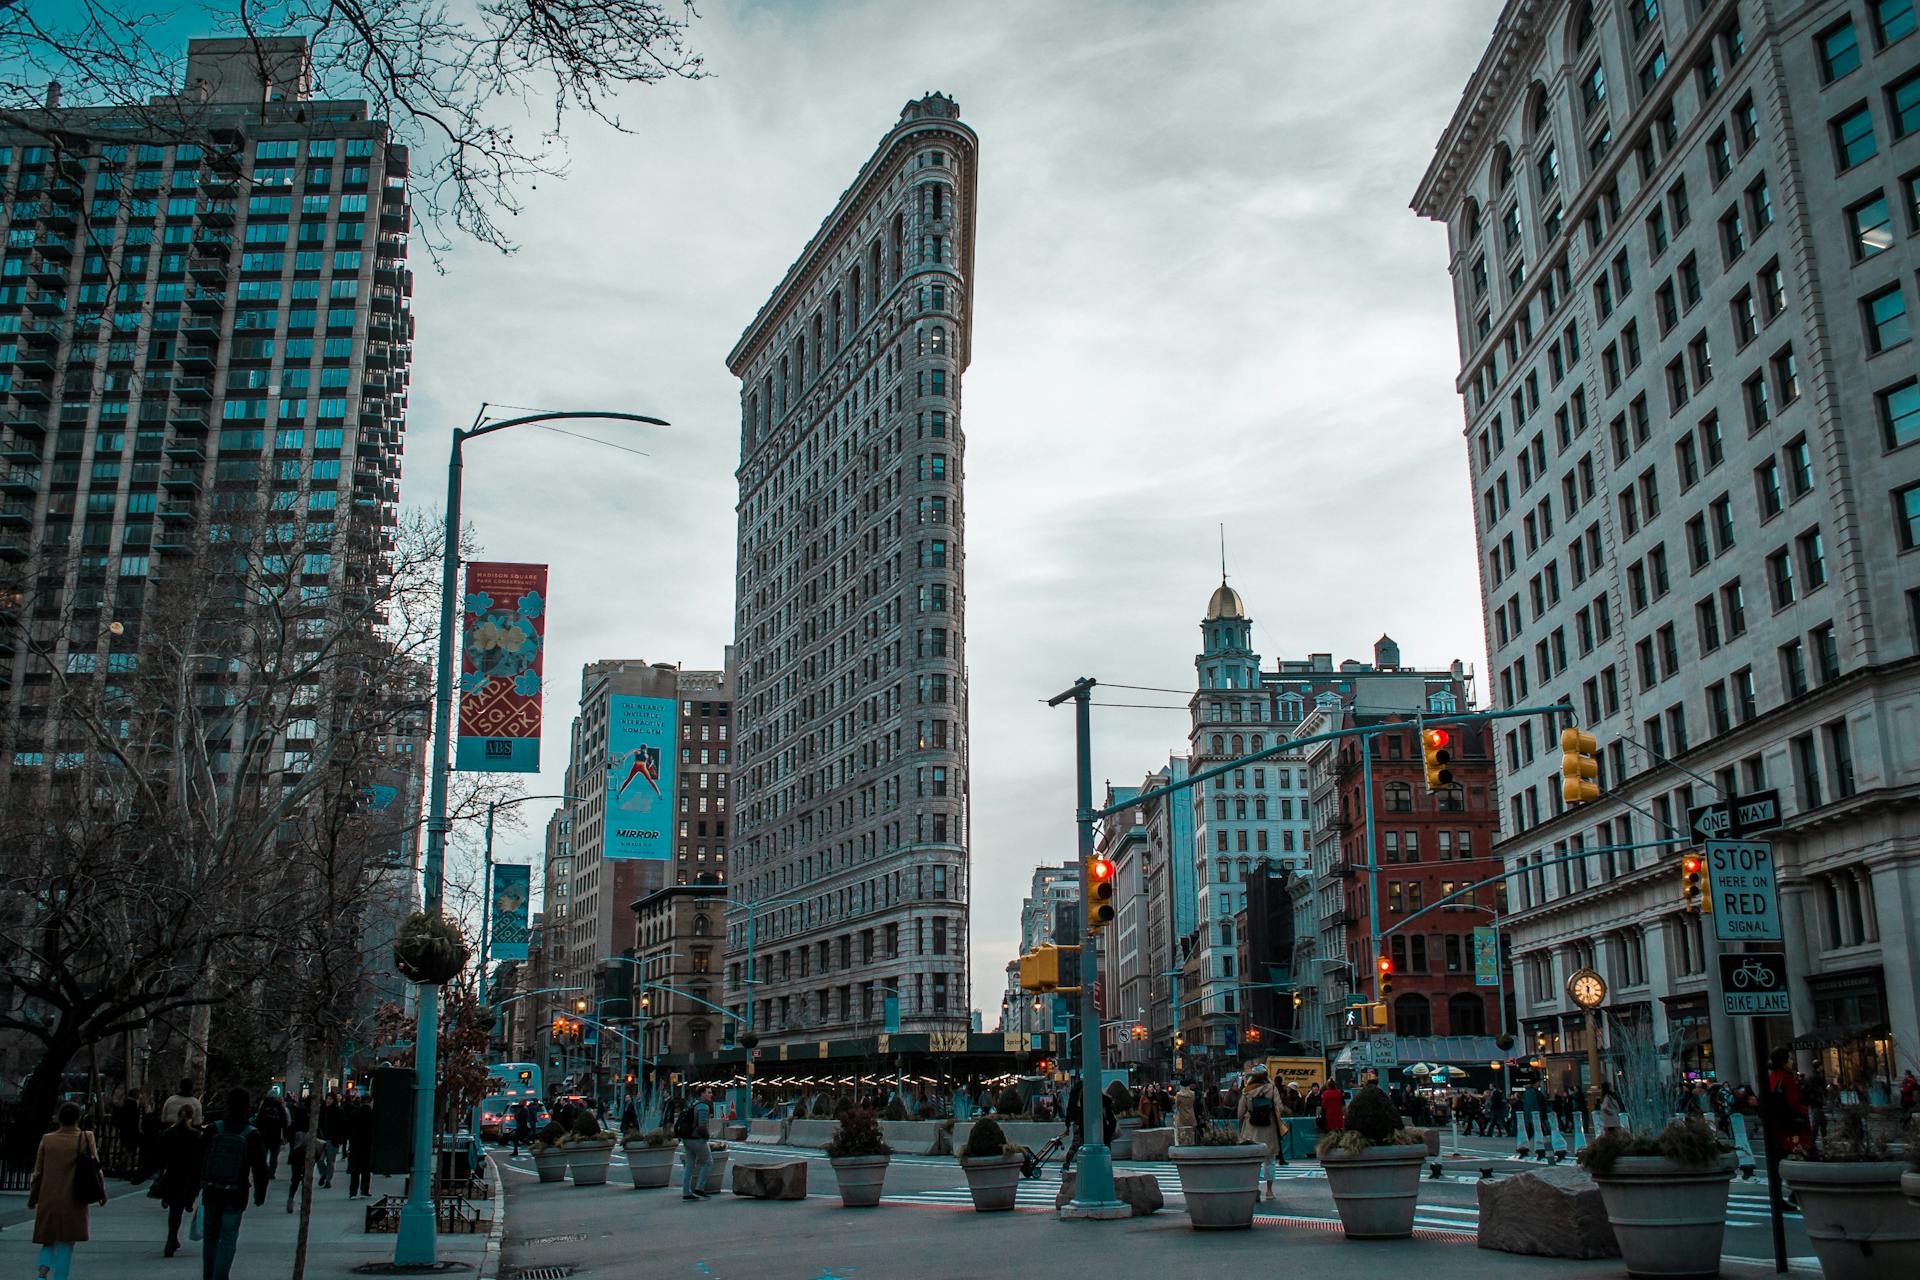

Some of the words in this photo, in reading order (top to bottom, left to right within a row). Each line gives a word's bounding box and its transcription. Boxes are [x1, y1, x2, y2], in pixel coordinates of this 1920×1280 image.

[623, 711, 661, 719] INVISIBLE
[618, 719, 665, 727] INTERACTIVE
[486, 741, 512, 754] ABS
[1702, 812, 1728, 832] ONE
[1739, 803, 1768, 823] WAY
[616, 829, 660, 839] MIRROR
[1714, 849, 1767, 871] STOP
[1719, 876, 1748, 888] HERE
[1753, 876, 1768, 888] ON
[1725, 893, 1766, 915] RED
[1728, 920, 1769, 933] SIGNAL
[1726, 996, 1753, 1011] BIKE
[1757, 994, 1788, 1010] LANE
[1276, 1068, 1317, 1076] PENSKE
